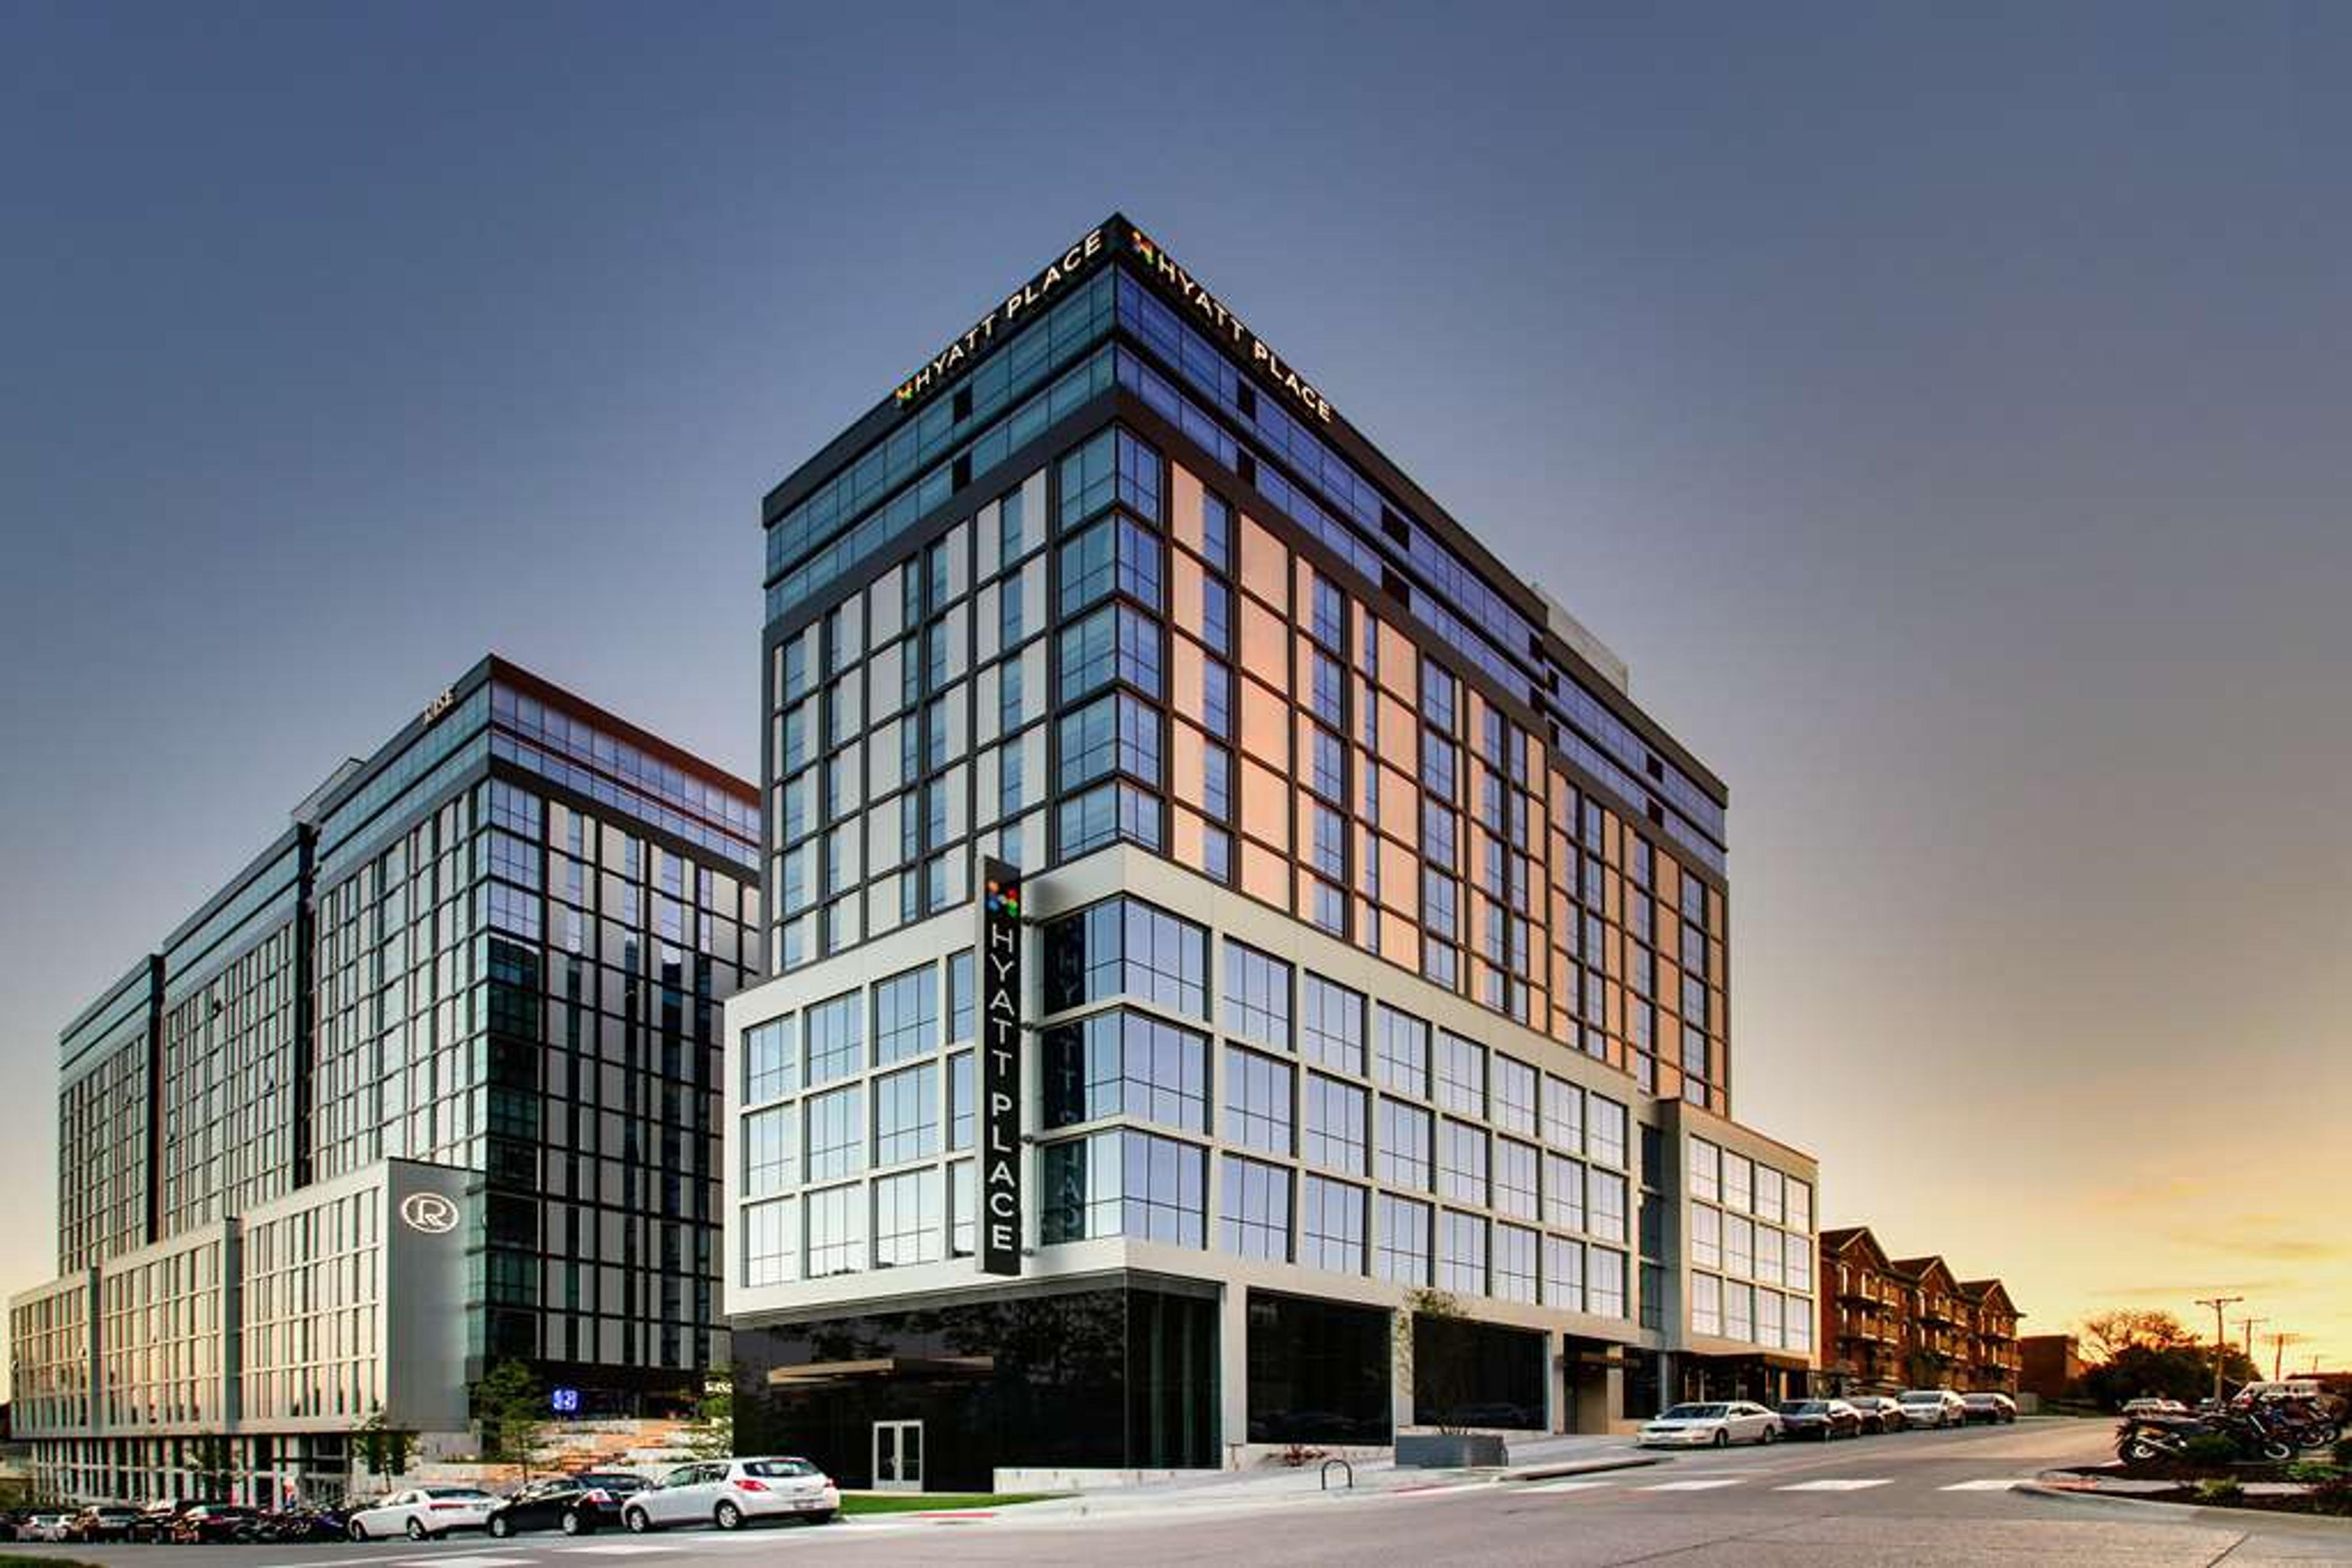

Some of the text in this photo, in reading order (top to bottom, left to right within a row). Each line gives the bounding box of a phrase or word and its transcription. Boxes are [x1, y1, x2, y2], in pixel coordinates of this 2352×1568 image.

[916, 229, 1102, 392] HYATT PLACE
[1158, 253, 1330, 423] HYATT PLACE
[989, 923, 1016, 1251] HYATT PLACE
